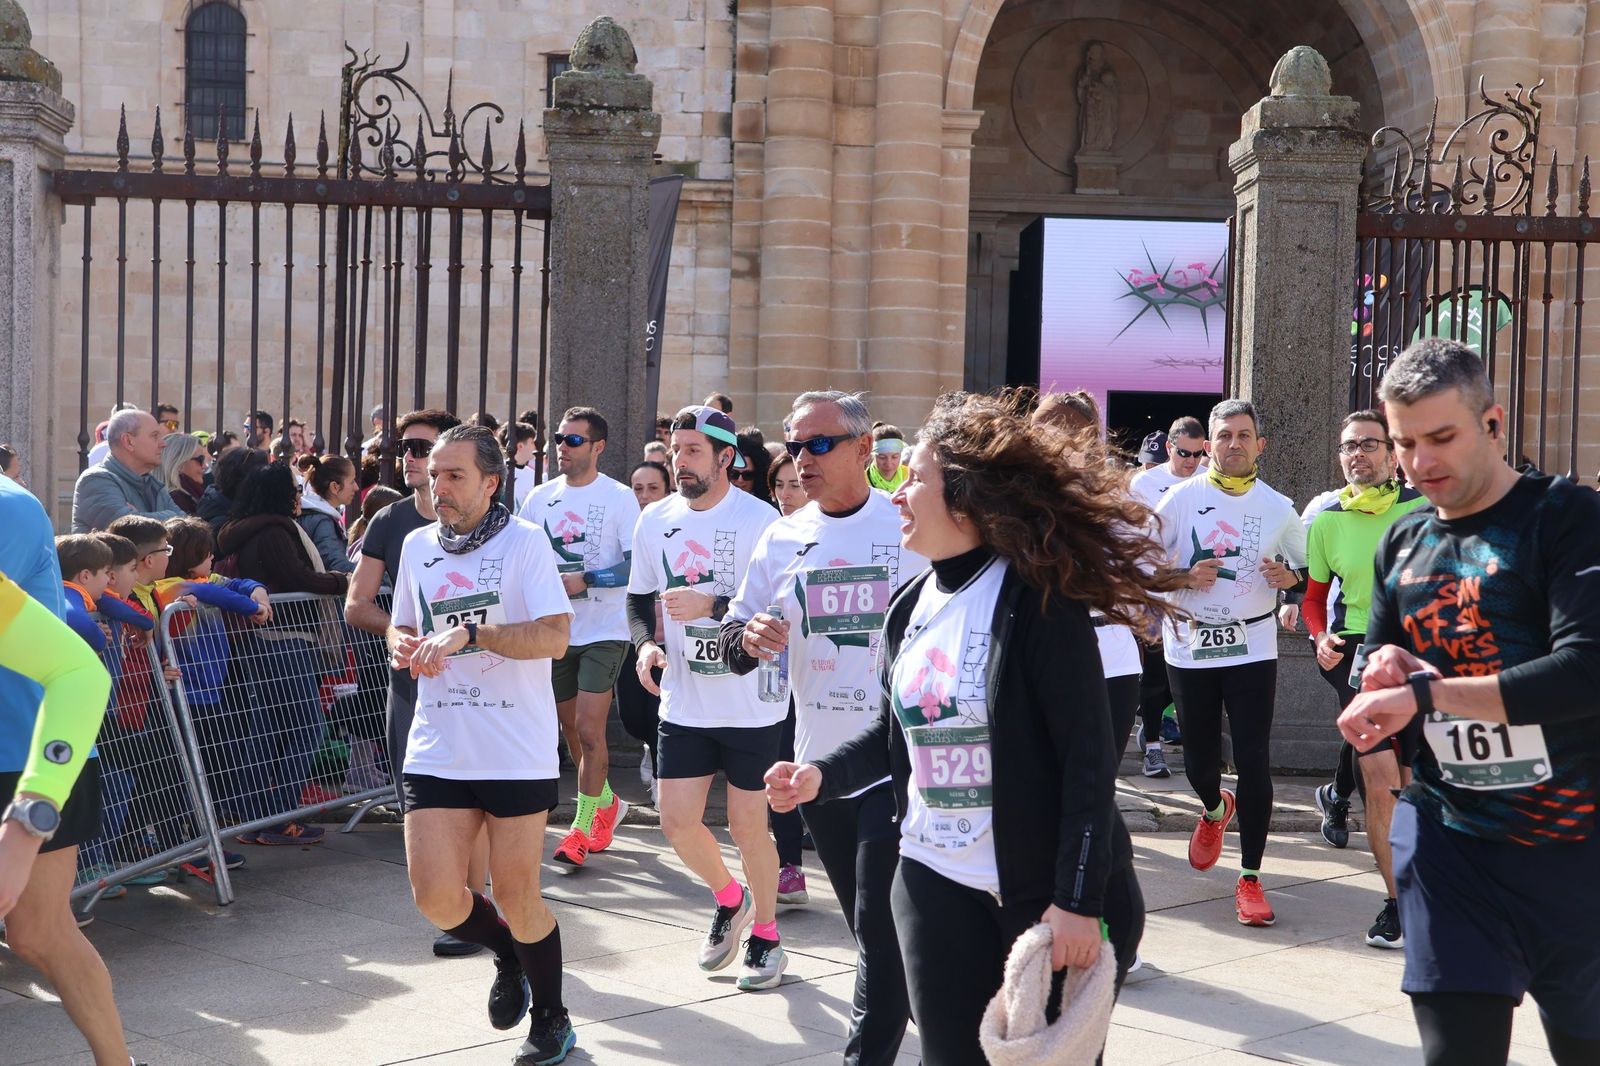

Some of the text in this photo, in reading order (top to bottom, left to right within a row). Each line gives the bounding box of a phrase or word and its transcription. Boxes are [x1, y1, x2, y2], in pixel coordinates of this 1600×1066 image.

[821, 583, 874, 614] 678
[1438, 575, 1481, 608] SAN
[695, 639, 719, 661] 26
[1200, 627, 1236, 647] 263
[1441, 631, 1500, 660] VES
[1446, 723, 1513, 761] 161
[930, 746, 992, 785] 529
